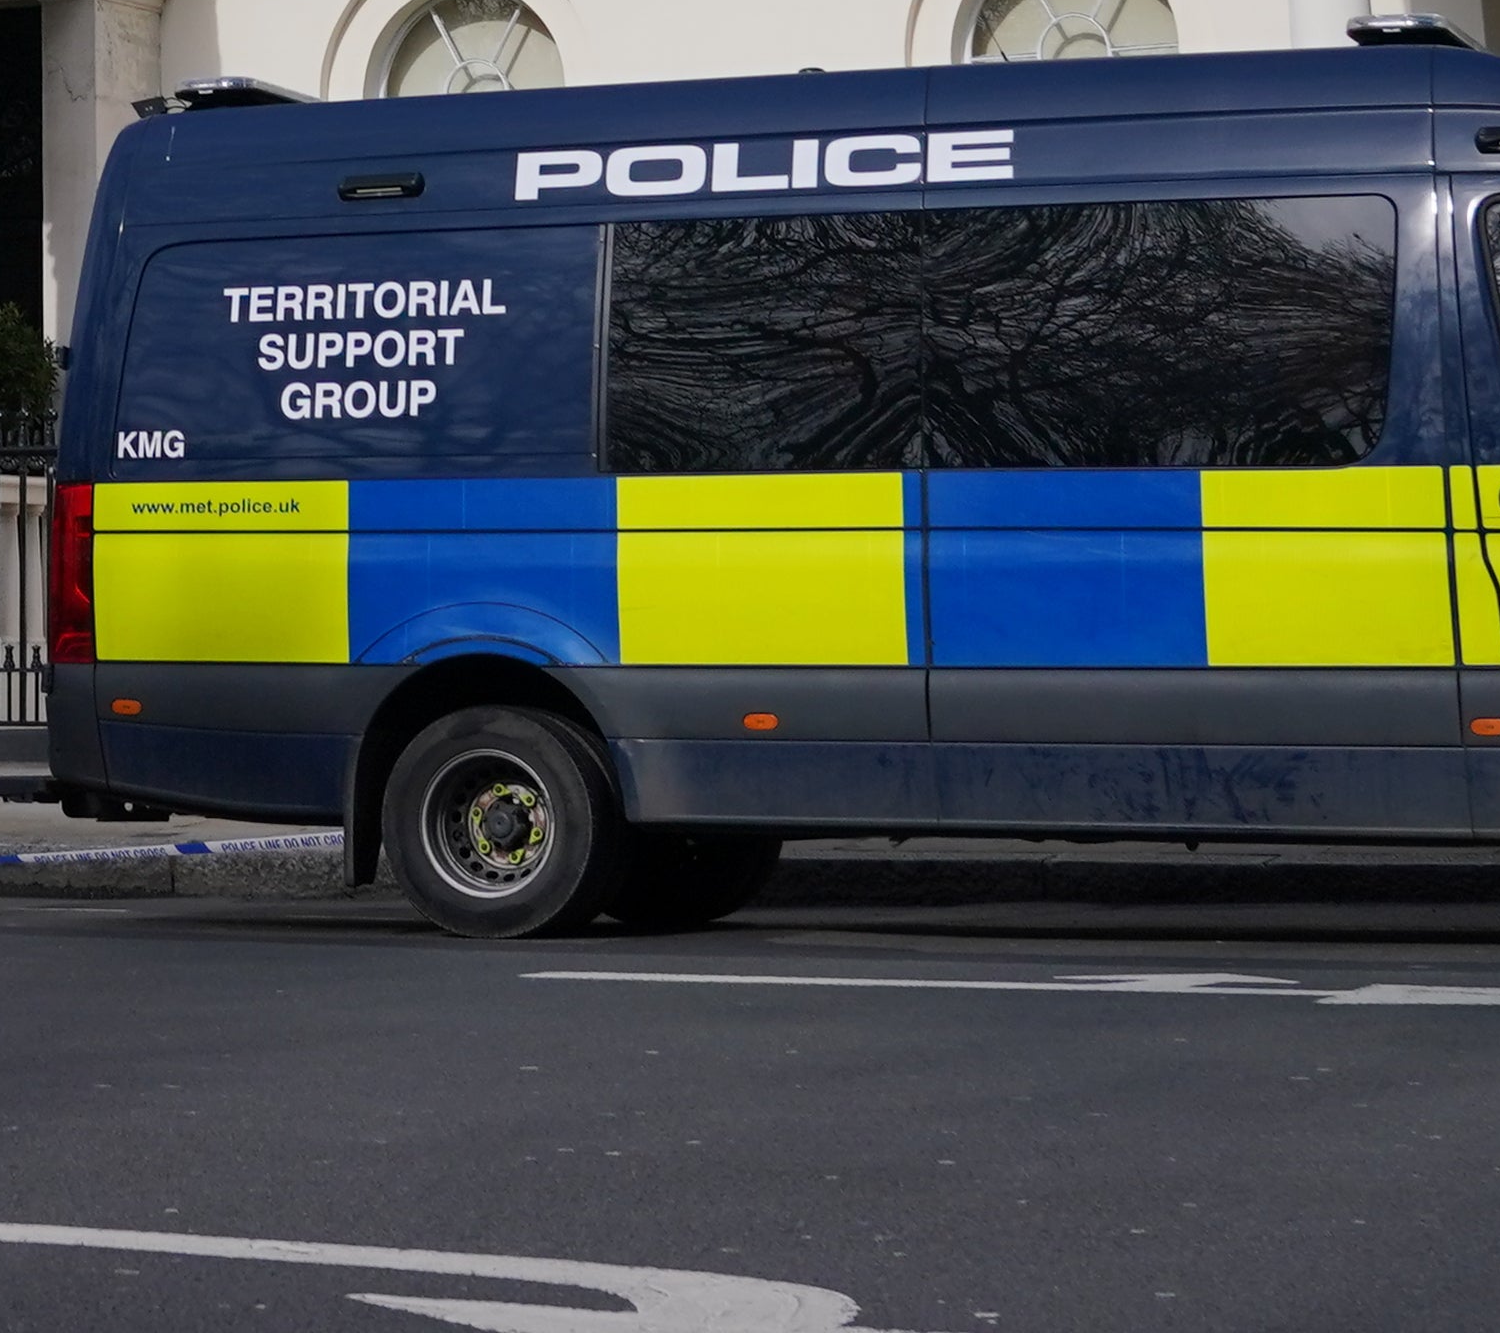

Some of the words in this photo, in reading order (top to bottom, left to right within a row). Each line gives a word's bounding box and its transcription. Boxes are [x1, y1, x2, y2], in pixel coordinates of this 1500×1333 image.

[513, 129, 1015, 201] POLICE
[223, 278, 507, 323] TERRITORIAL
[257, 328, 465, 371] SUPPORT
[280, 380, 437, 420] GROUP
[116, 430, 186, 459] KMG
[131, 498, 300, 517] www.met.police.uk
[284, 838, 299, 849] DO
[301, 836, 321, 847] NOT
[324, 834, 345, 846] CRO
